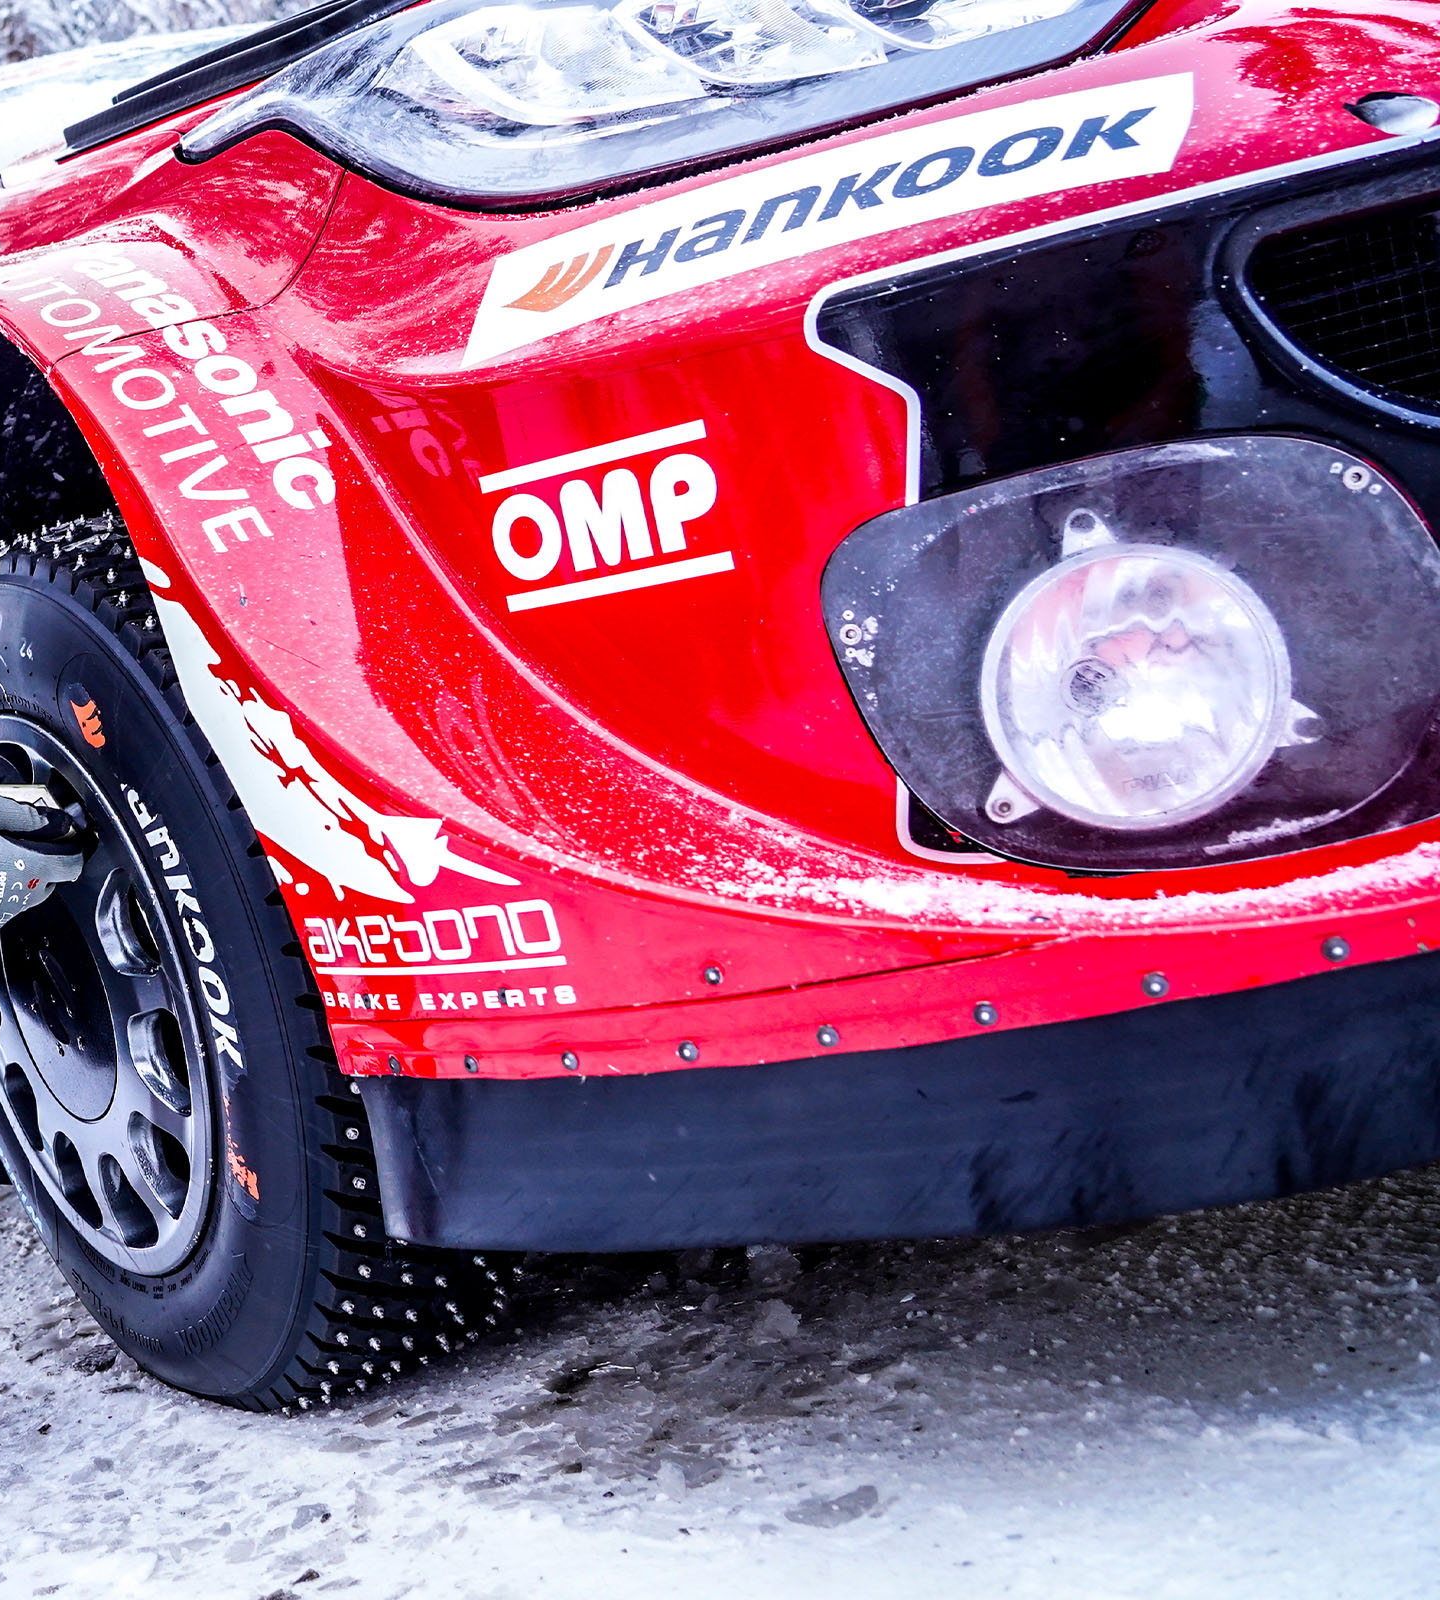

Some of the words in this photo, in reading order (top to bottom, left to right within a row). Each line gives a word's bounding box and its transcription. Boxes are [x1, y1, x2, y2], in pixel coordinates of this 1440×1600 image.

[70, 247, 337, 511] anasonic
[492, 452, 718, 582] OMP
[323, 991, 401, 1010] BRAKE
[419, 985, 578, 1011] EXPERTS
